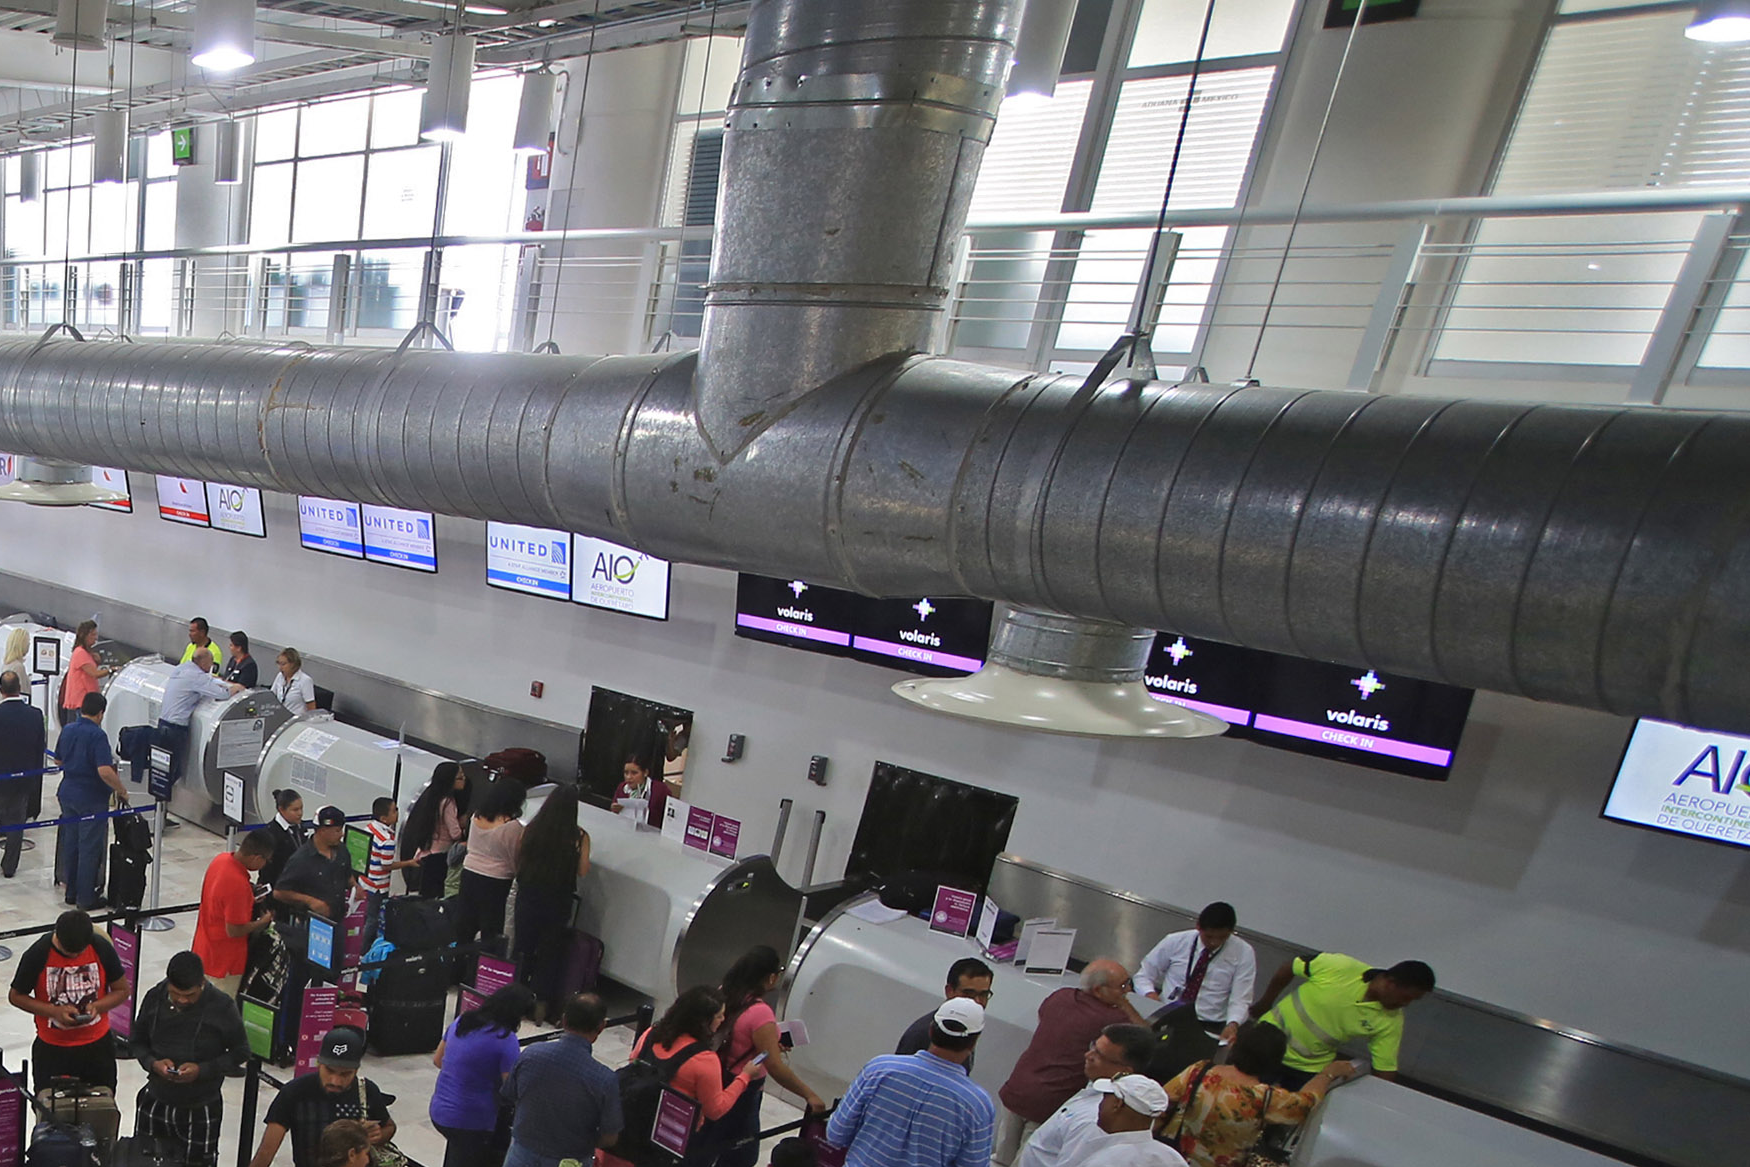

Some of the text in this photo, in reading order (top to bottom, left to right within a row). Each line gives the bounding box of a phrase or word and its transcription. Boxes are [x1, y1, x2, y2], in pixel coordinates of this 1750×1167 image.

[300, 504, 344, 522] UNITED
[365, 515, 413, 533] UNITED
[490, 536, 547, 556] UNITED
[592, 552, 635, 584] AIO
[777, 605, 814, 622] volaris
[776, 623, 807, 636] CHECK IN
[899, 629, 941, 647] volaris
[898, 647, 932, 661] CHECK IN
[1145, 674, 1197, 695] volaris
[1326, 709, 1389, 732] volaris
[1322, 730, 1374, 748] CHECK IN
[1657, 813, 1680, 827] DE
